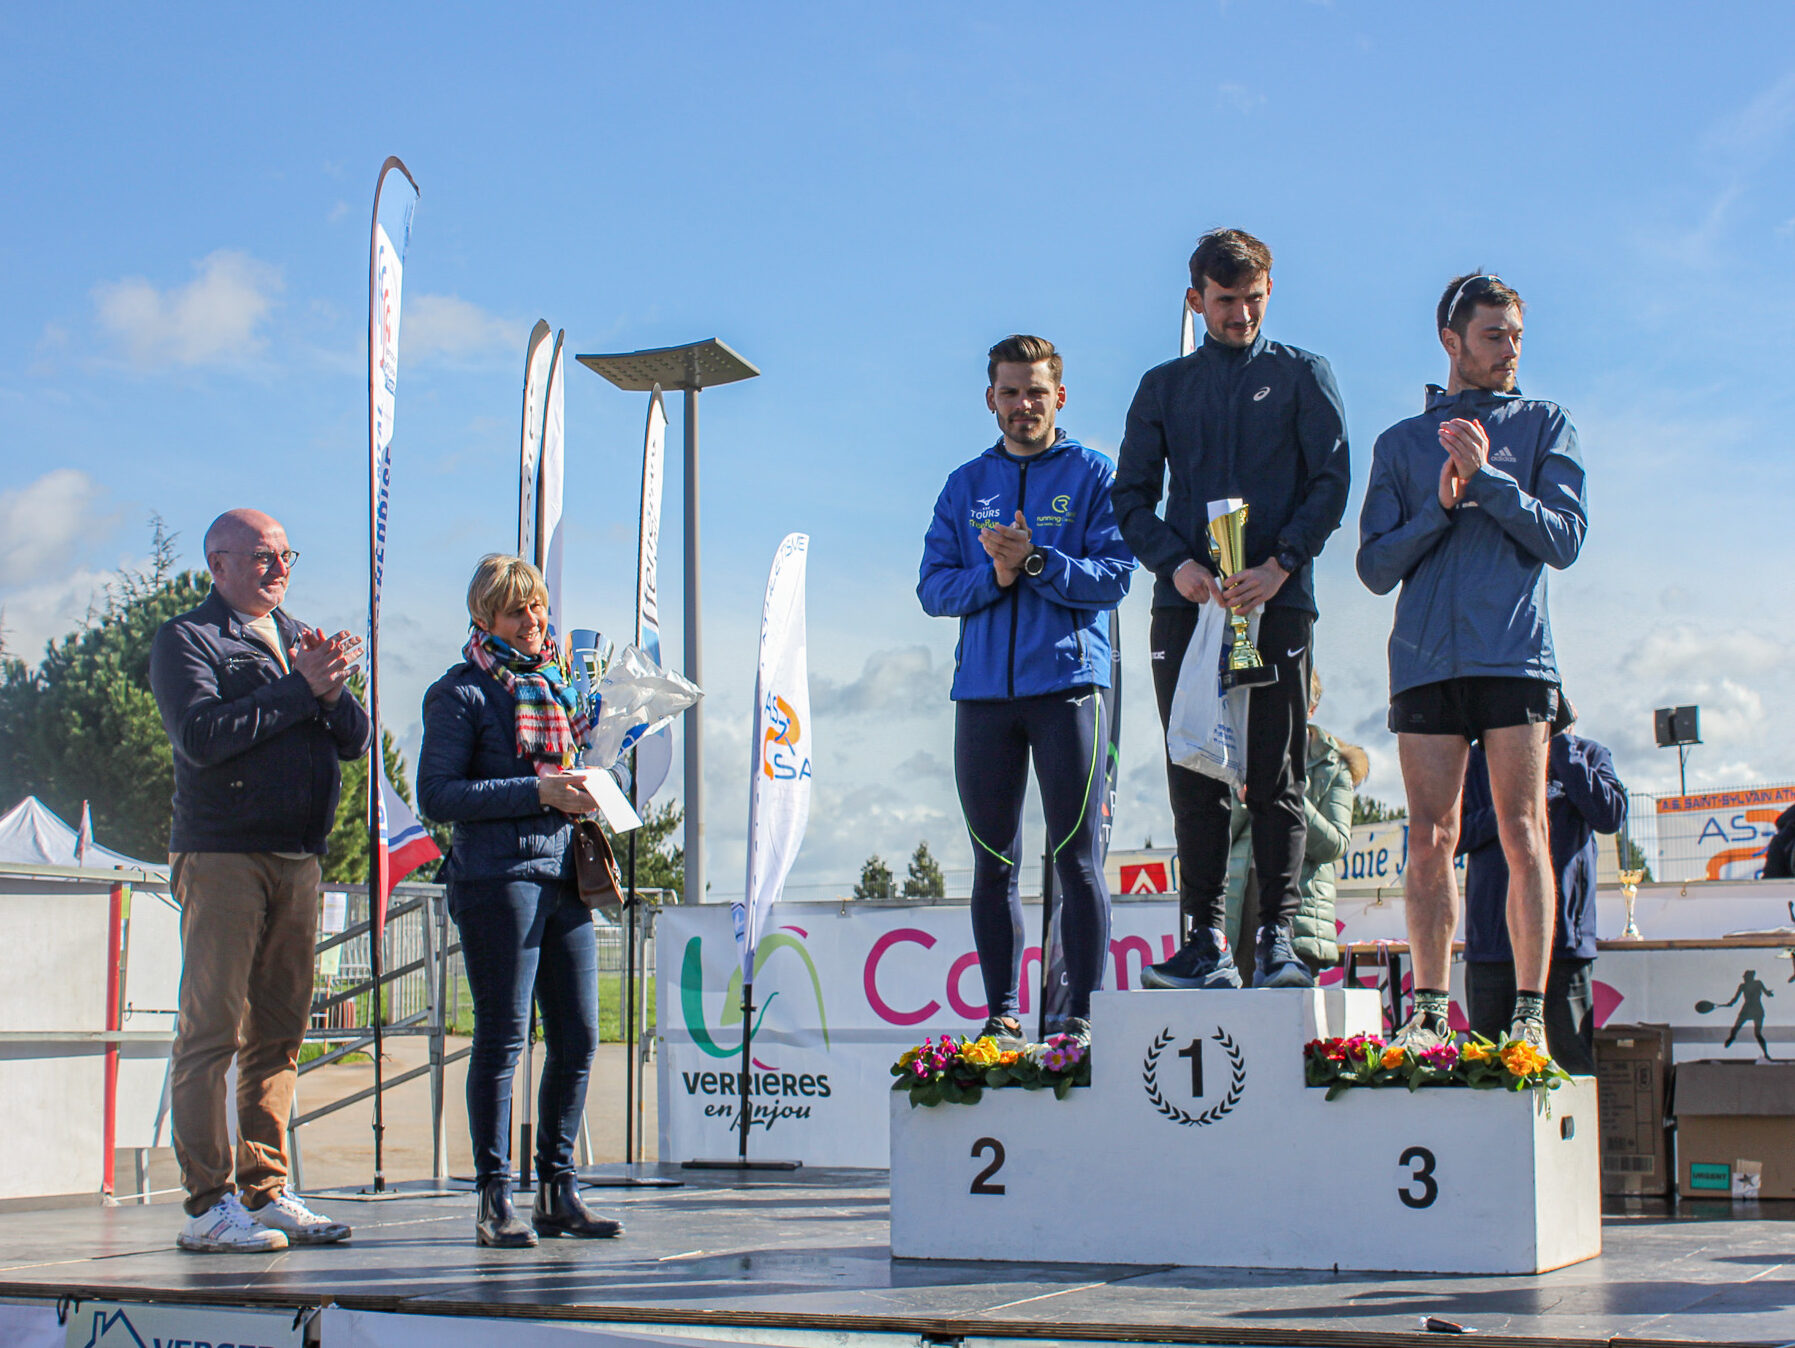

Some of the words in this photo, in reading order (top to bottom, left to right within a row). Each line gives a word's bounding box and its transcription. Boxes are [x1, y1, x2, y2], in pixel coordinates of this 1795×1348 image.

[970, 509, 1000, 520] TOURS
[1178, 1039, 1202, 1098] 1
[704, 1104, 732, 1117] en
[969, 1137, 1006, 1195] 2
[1398, 1146, 1439, 1209] 3
